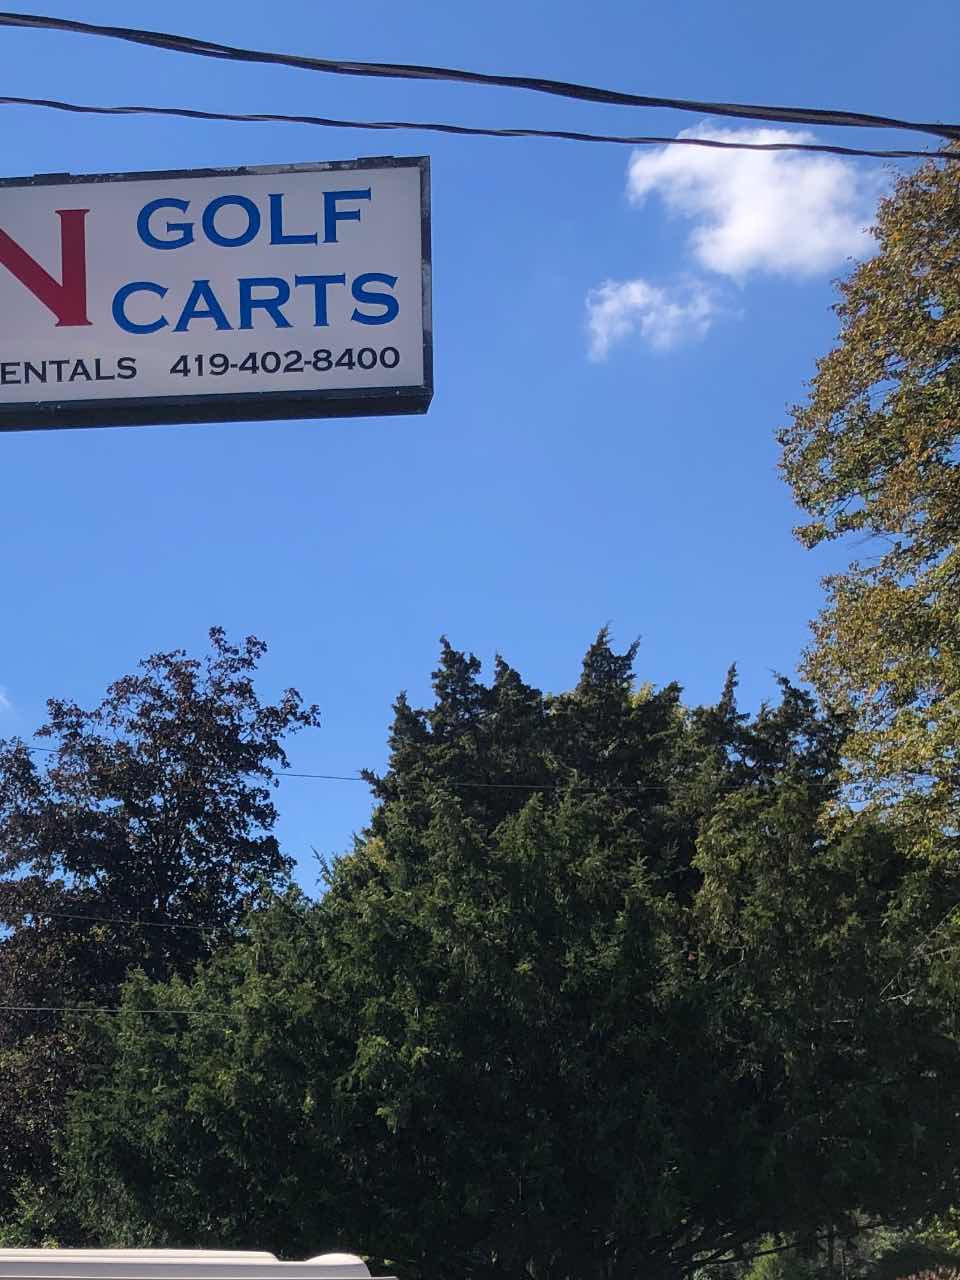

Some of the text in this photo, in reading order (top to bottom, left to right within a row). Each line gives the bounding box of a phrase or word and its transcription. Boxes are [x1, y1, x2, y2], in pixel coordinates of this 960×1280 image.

[136, 187, 372, 250] GOLF
[112, 272, 400, 335] CARTS
[169, 347, 401, 377] 419-402-8400
